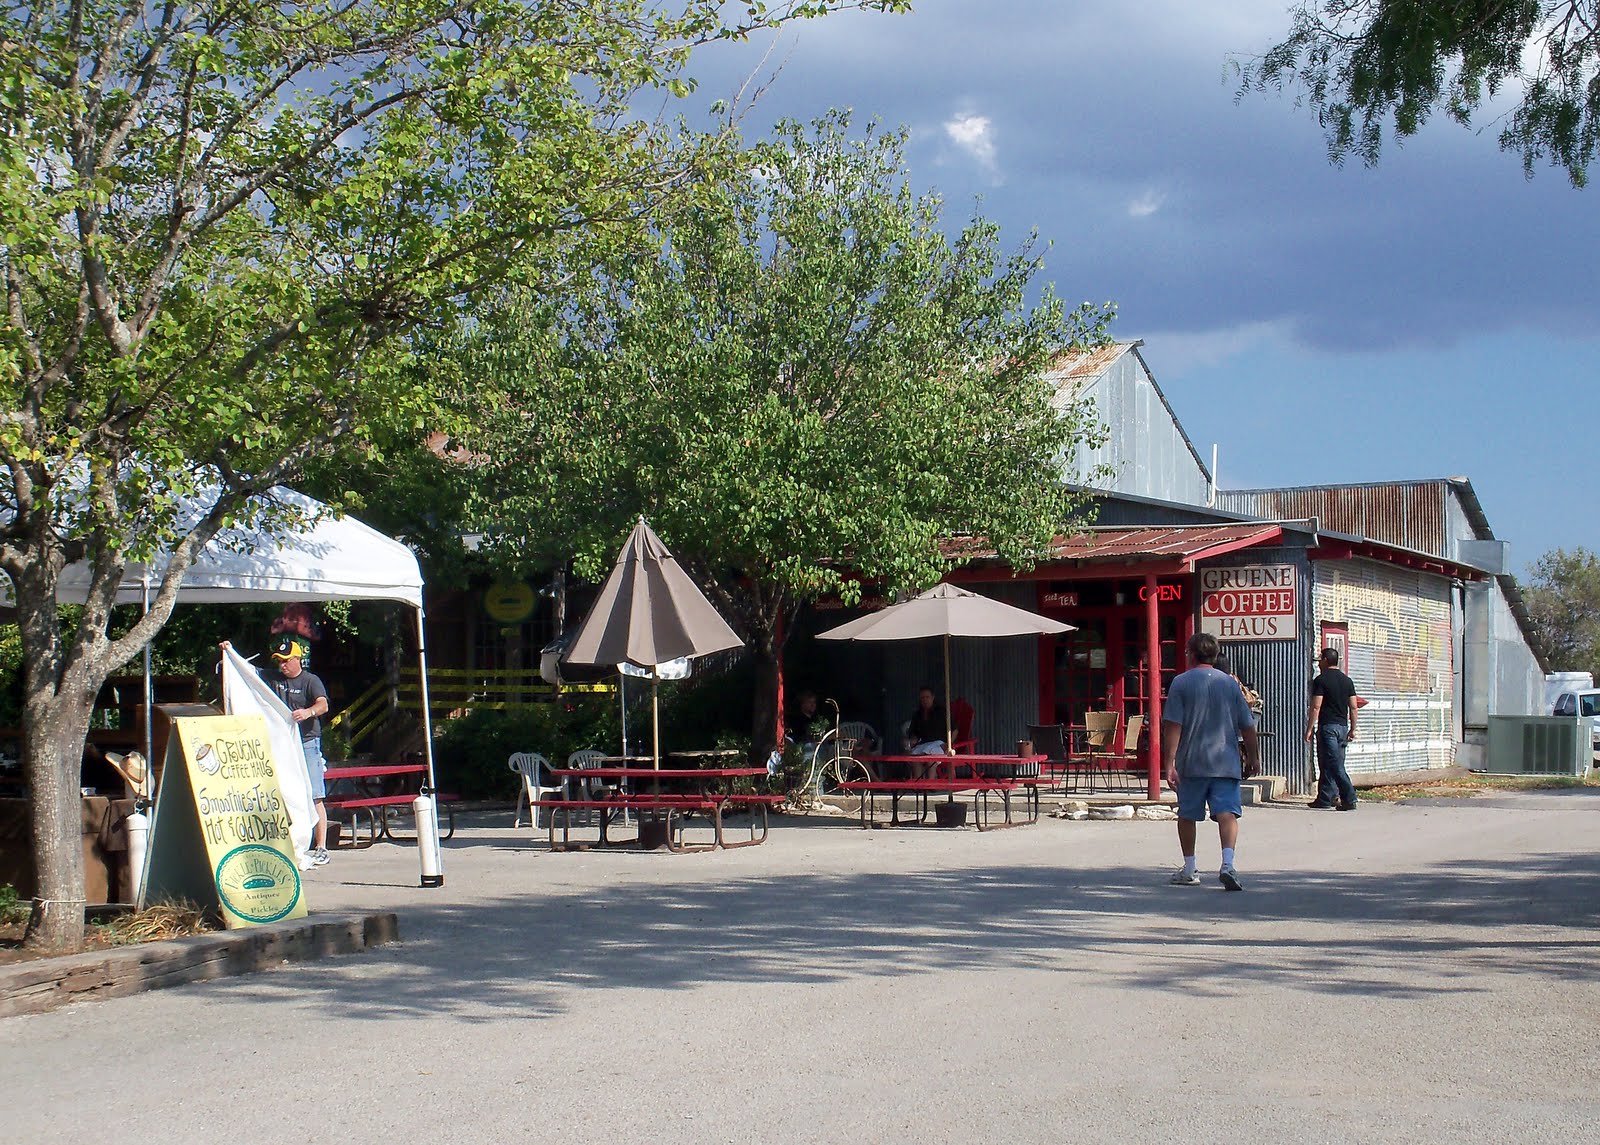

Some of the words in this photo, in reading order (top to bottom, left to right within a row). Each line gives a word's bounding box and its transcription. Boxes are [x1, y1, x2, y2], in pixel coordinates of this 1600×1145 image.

[1203, 568, 1292, 589] GRUENE
[1058, 594, 1077, 606] TEA
[1204, 592, 1292, 614] COFFEE
[1220, 617, 1277, 636] HAUS
[216, 738, 264, 764] GRUENE
[220, 763, 251, 779] COFFEE
[250, 759, 274, 777] HAUS
[205, 816, 228, 844] Hot
[244, 892, 279, 900] Antiques
